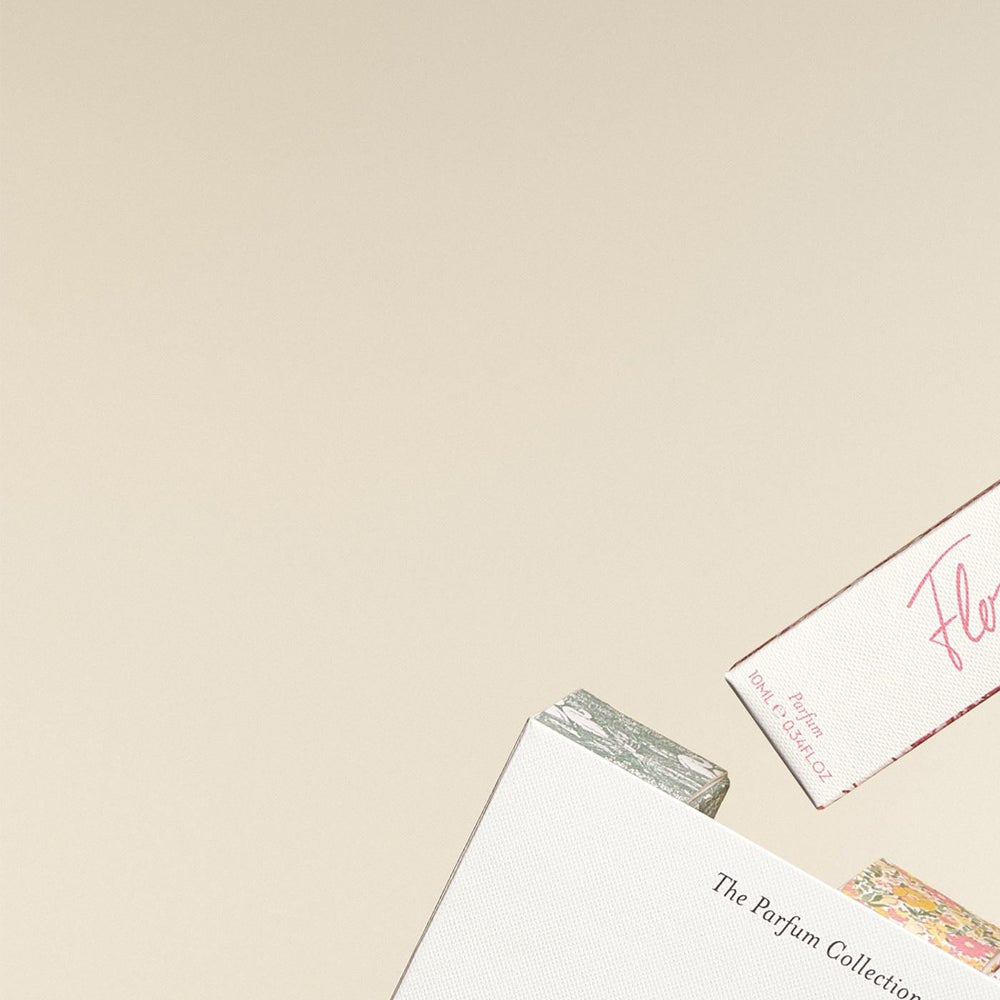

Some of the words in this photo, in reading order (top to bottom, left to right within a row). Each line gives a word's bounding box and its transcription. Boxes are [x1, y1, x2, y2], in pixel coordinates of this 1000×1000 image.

[748, 669, 774, 705] 10ML
[789, 691, 823, 739] Parfum
[712, 872, 748, 906] The
[751, 896, 820, 949] Parfum
